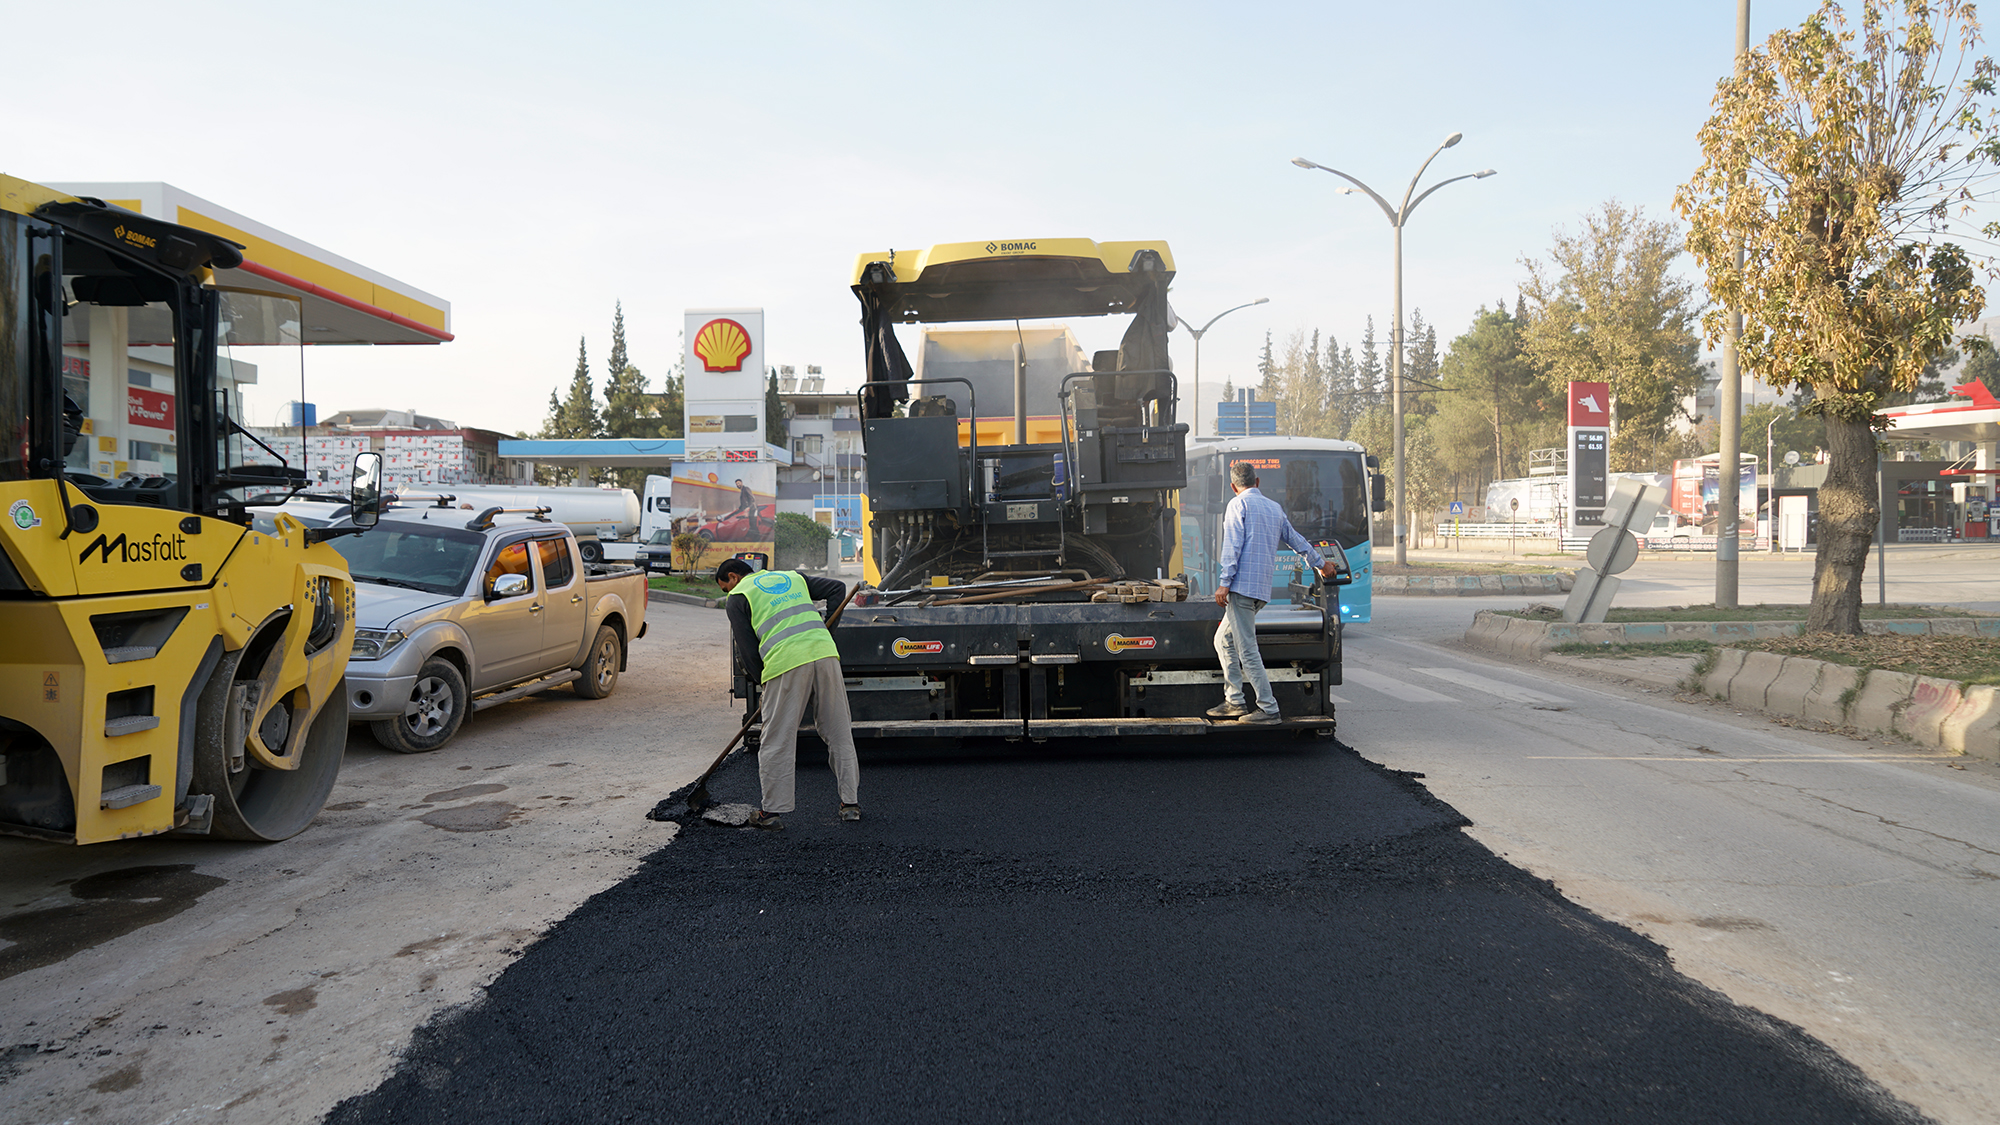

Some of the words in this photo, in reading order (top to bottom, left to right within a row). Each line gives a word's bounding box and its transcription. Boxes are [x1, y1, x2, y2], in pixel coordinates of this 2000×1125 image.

[126, 230, 157, 248] BOMAG
[1001, 242, 1037, 251] BOMAG
[129, 406, 165, 421] V-Power
[79, 533, 187, 565] Masfalt
[1275, 555, 1302, 563] ÜKŞEHİR
